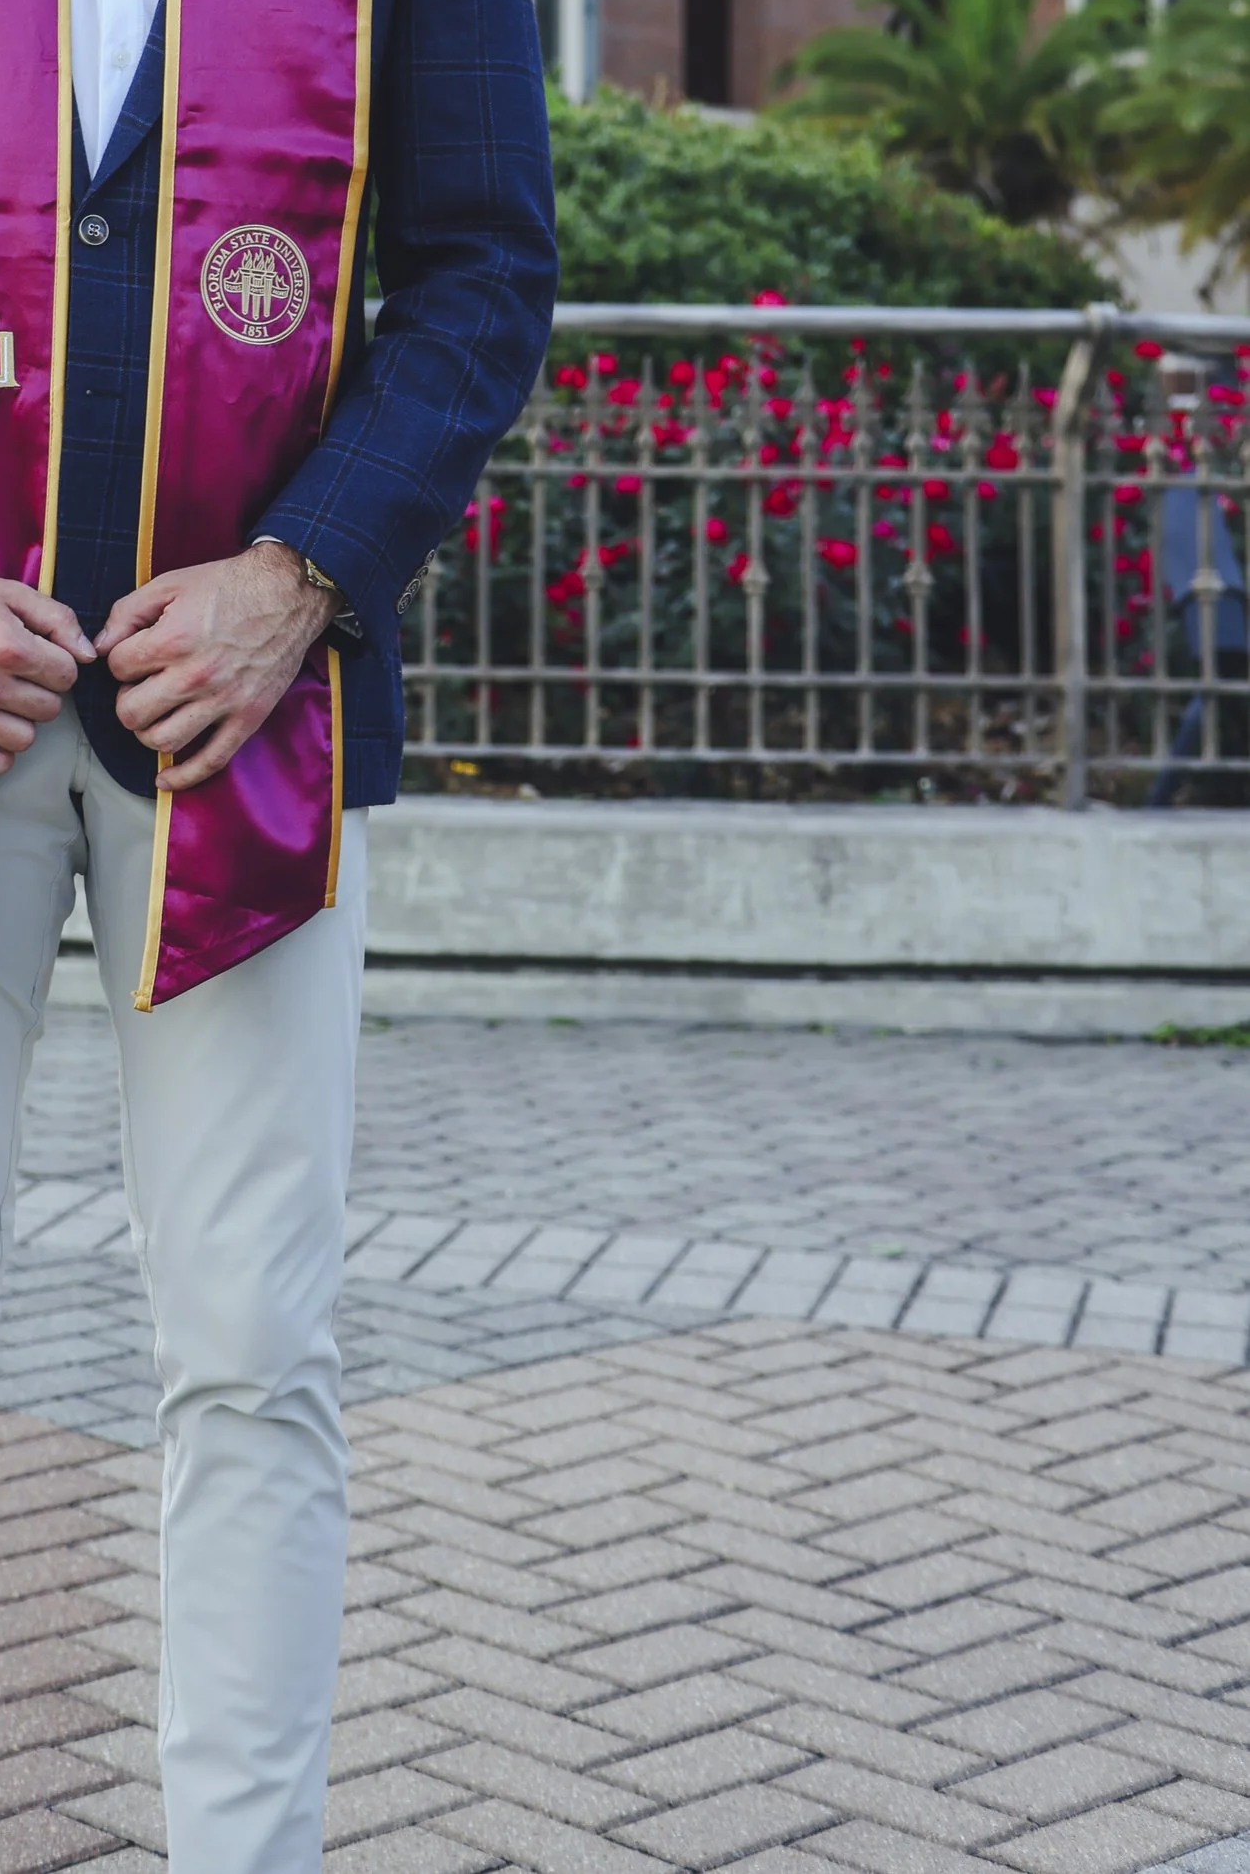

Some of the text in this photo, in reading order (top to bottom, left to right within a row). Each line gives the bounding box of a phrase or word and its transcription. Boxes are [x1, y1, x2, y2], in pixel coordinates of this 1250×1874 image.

[208, 232, 304, 321] FLORIDA STATE UNIVERSITY
[241, 324, 269, 338] 1851
